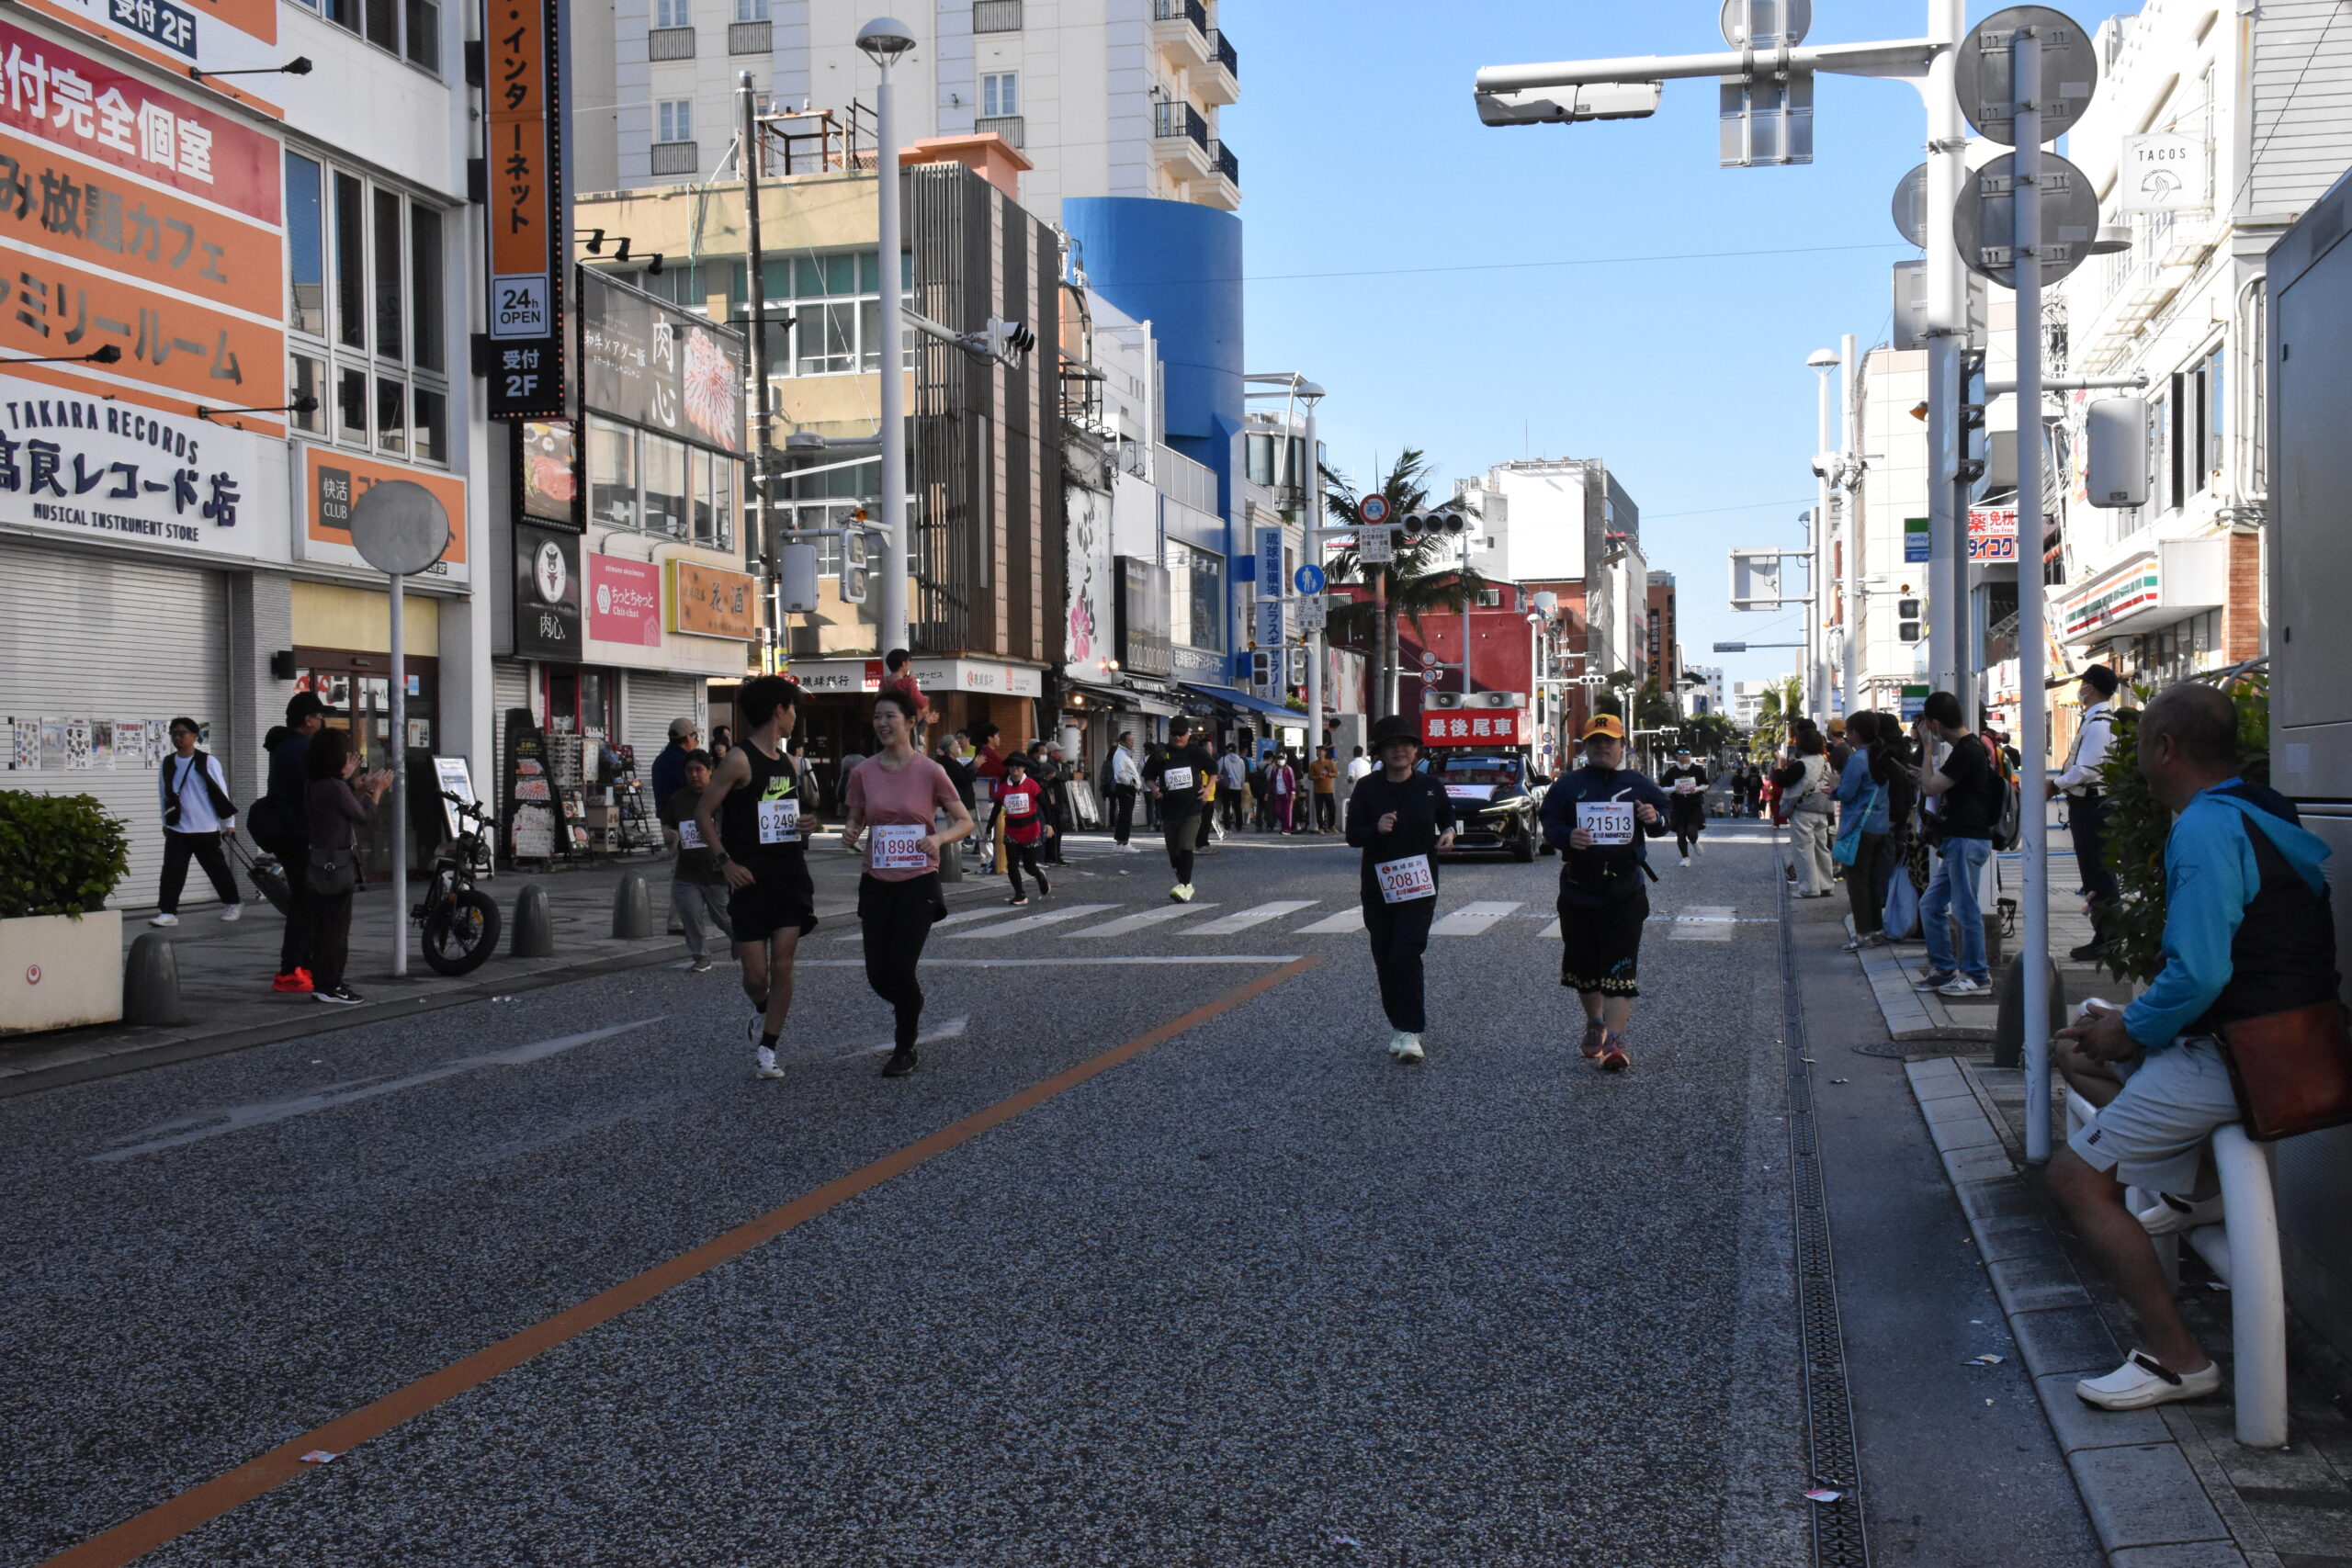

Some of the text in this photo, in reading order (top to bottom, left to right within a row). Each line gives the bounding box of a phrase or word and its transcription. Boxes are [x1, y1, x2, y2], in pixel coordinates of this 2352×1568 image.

[162, 10, 191, 49] 2F
[0, 43, 213, 185] 付完全個室
[2138, 148, 2186, 161] TACOS
[501, 310, 541, 324] OPEN
[503, 348, 540, 369] 受付
[651, 312, 676, 428] 肉心
[506, 375, 538, 397] 2F
[6, 400, 199, 465] TAKARA RECORDS
[322, 477, 348, 502] 快活
[323, 502, 347, 519] CLUB
[1989, 510, 2016, 526] 免税
[34, 502, 199, 542] MUSICAL INSTRUMENT STORE
[1906, 535, 1928, 544] Family
[1969, 537, 2013, 557] ダイコク
[613, 606, 639, 618] Chit-chat
[540, 612, 563, 639] 肉心
[802, 674, 850, 687] 琉球銀行
[1429, 717, 1512, 737] 最後尾車
[769, 776, 790, 791] RUN
[761, 815, 769, 830] C
[1380, 868, 1429, 891] L20813
